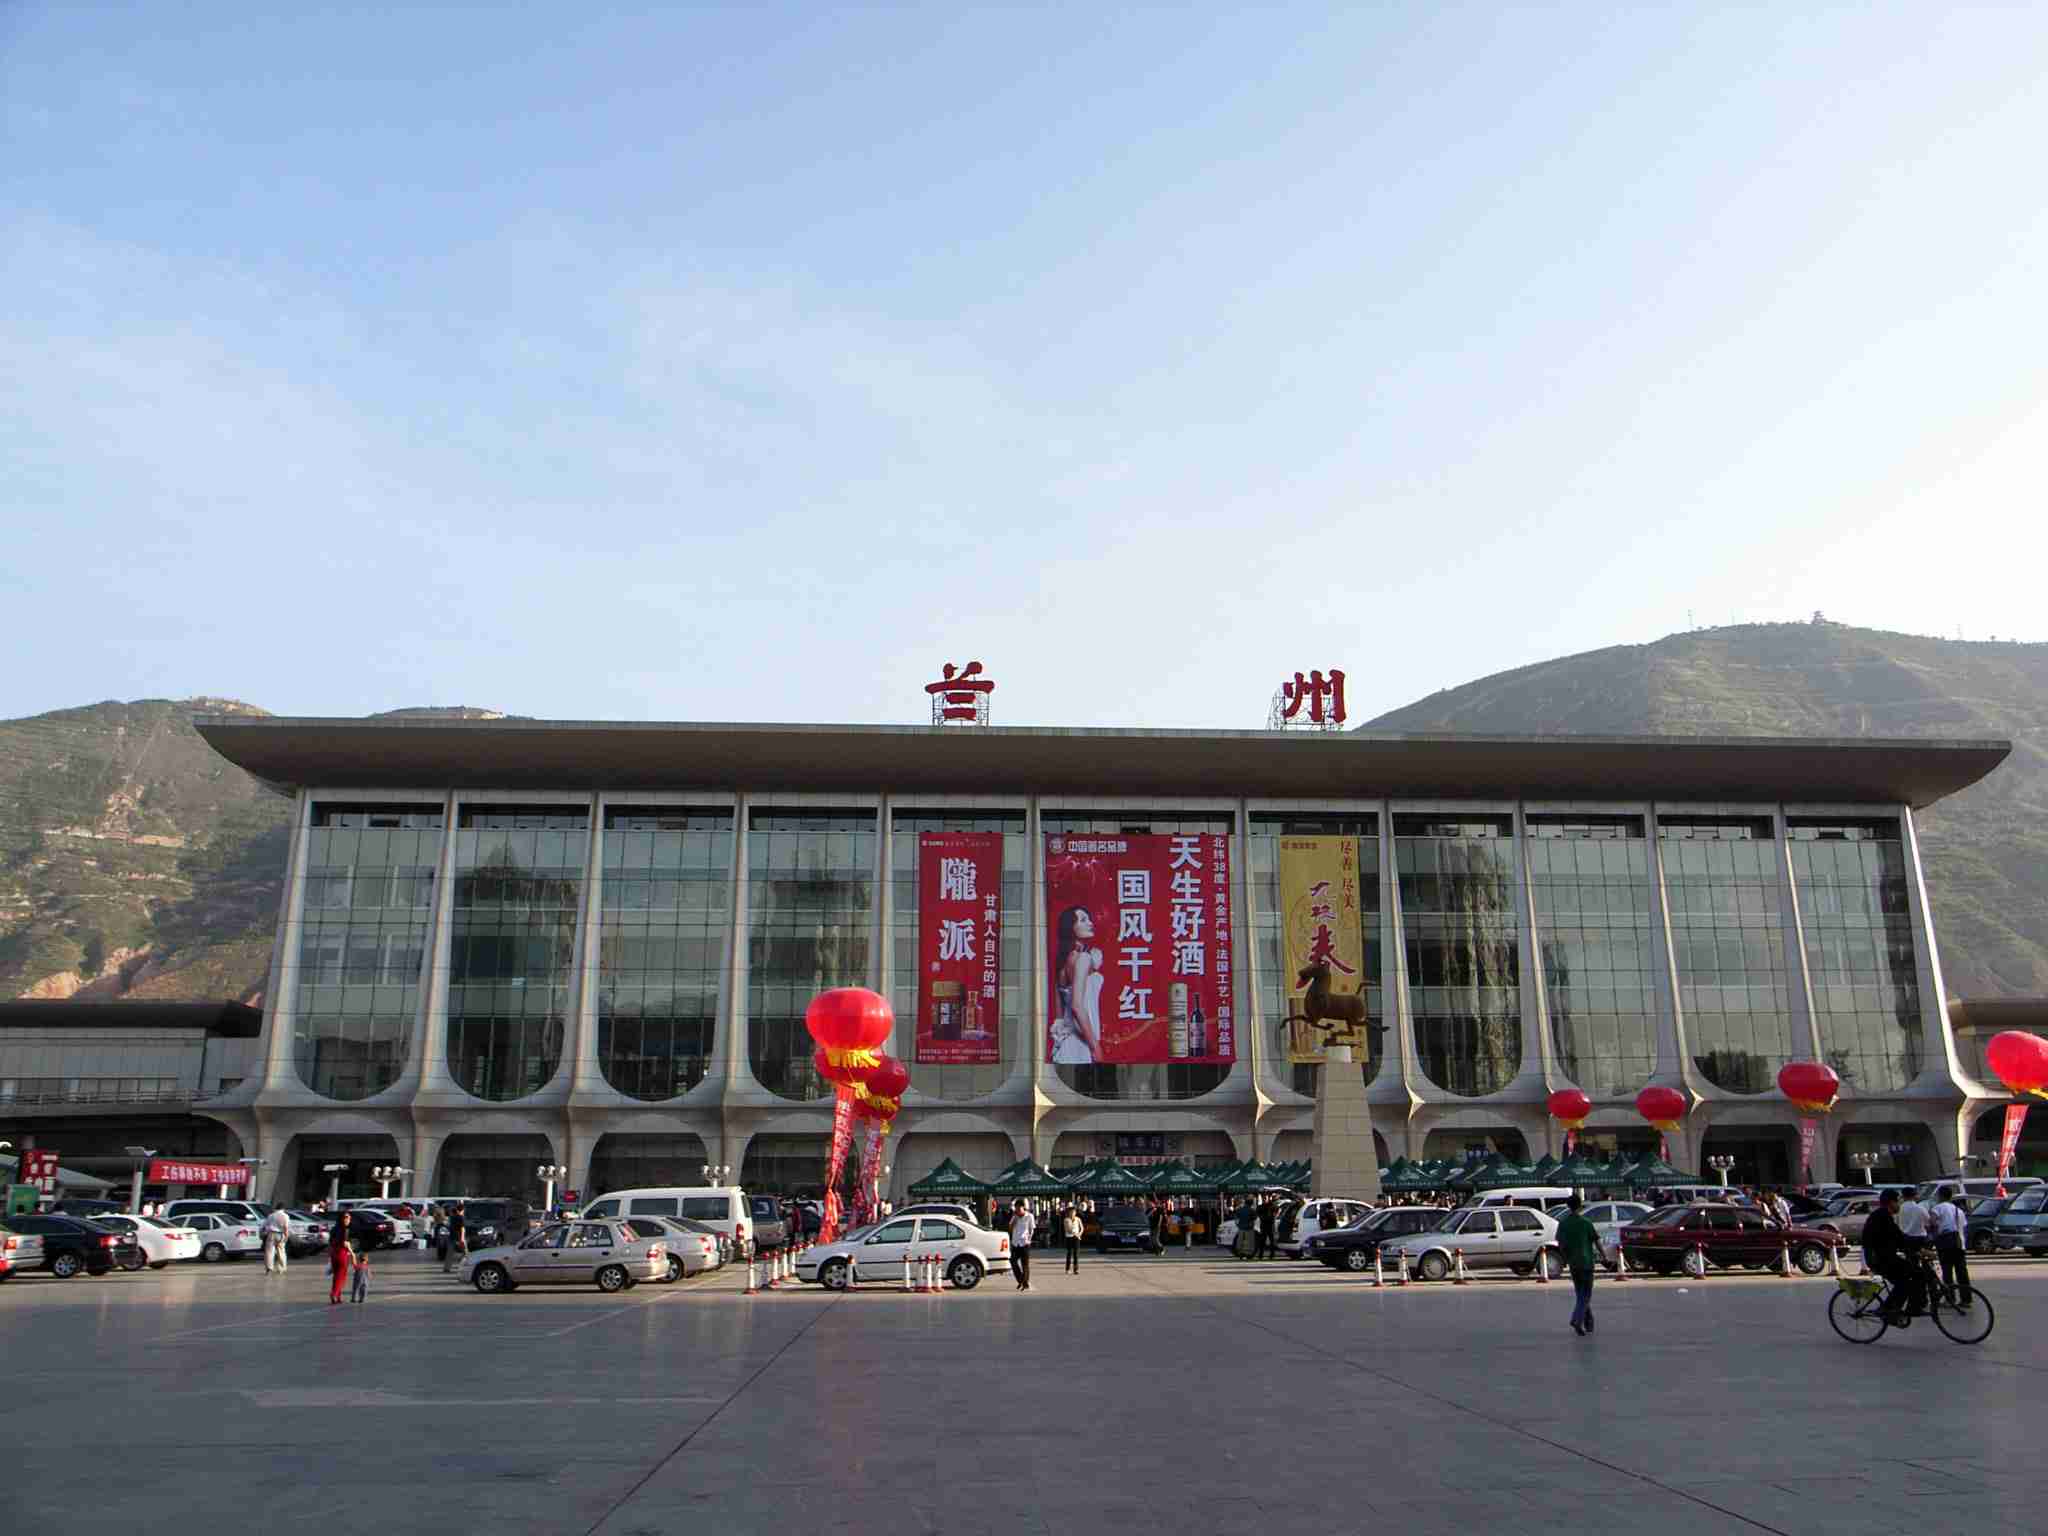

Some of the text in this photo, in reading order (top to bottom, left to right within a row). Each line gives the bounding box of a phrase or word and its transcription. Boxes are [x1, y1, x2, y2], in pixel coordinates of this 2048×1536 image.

[925, 661, 1346, 723] 兰 州
[1117, 869, 1154, 1021] 国风干红
[1168, 836, 1206, 976] 天生好酒
